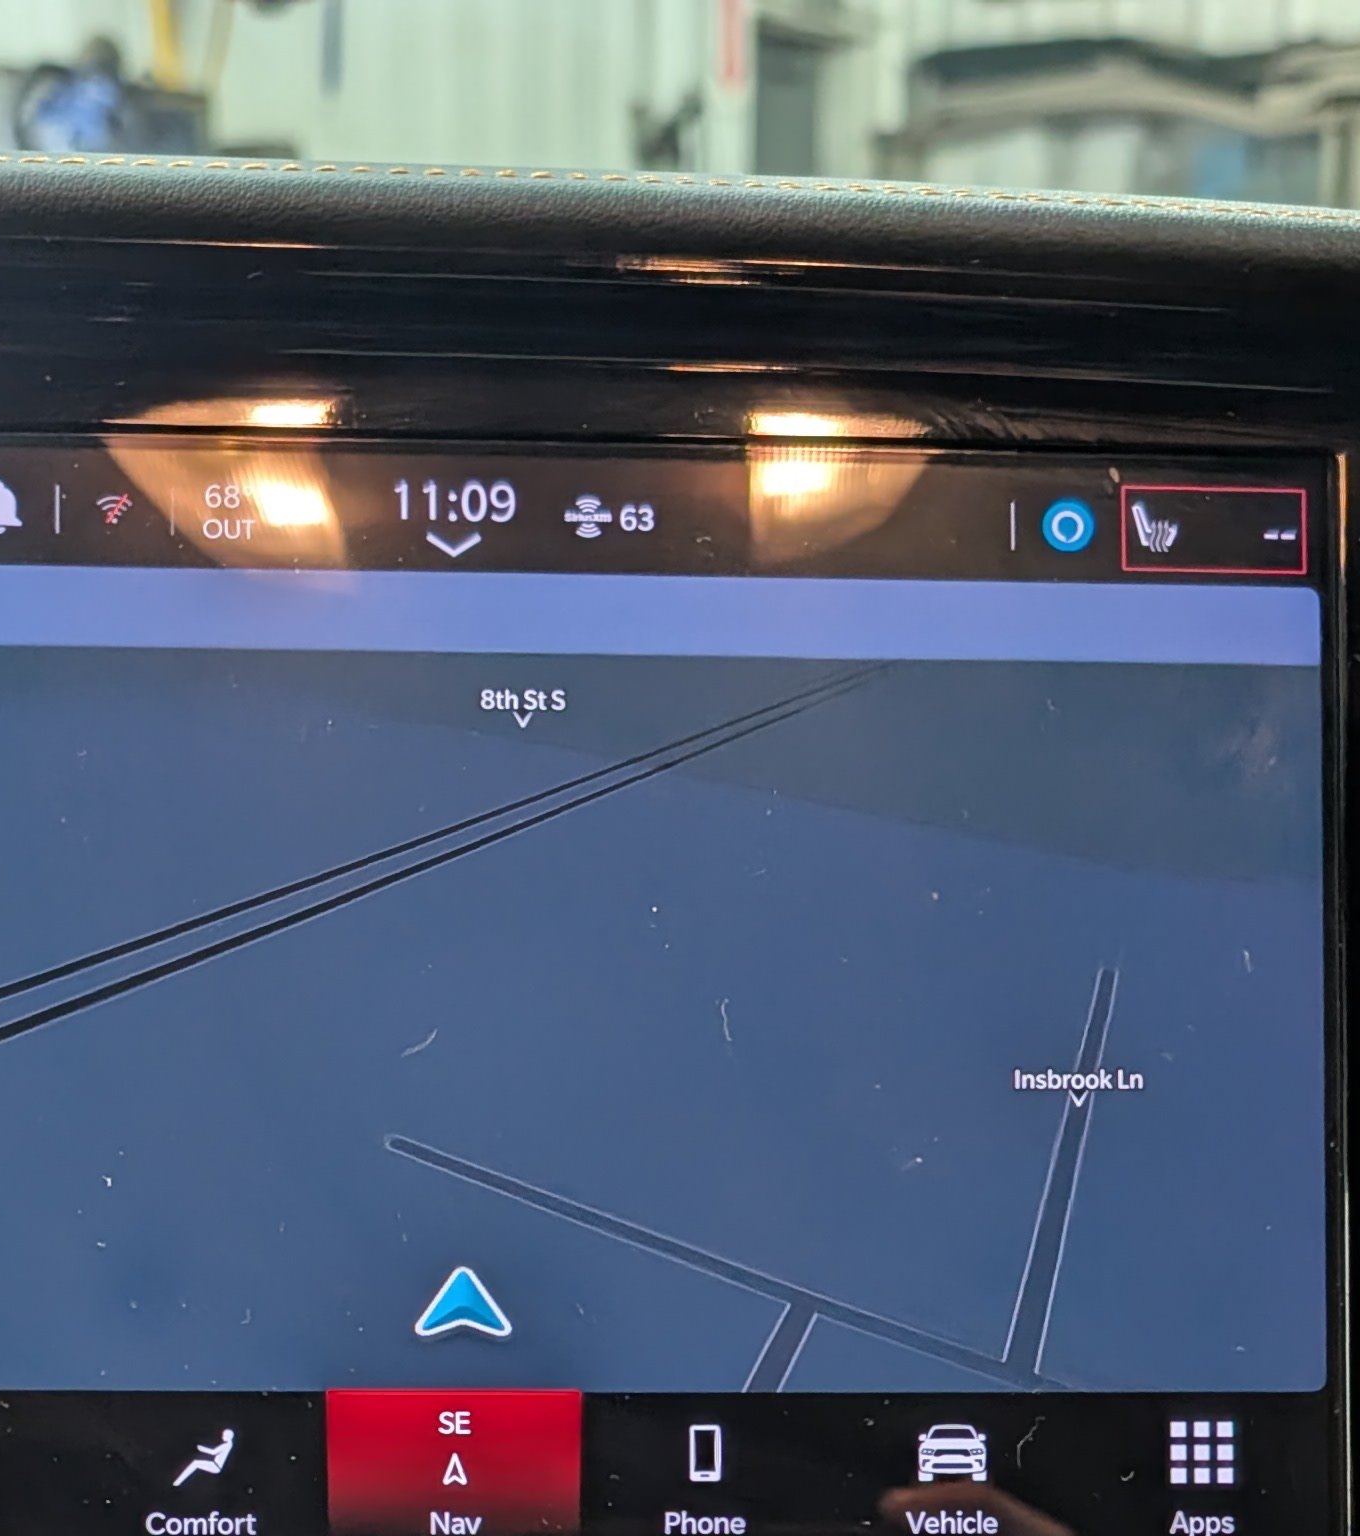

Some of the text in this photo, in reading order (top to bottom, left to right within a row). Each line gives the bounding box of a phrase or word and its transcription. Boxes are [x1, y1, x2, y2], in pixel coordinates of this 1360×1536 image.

[392, 479, 517, 524] 11:09
[201, 518, 255, 542] OUT
[619, 503, 655, 532] 63
[479, 688, 567, 713] 8th St S
[1013, 1068, 1145, 1092] Insbrook Ln
[438, 1411, 472, 1435] SE
[144, 1511, 258, 1536] Comfort
[429, 1512, 482, 1536] Nav
[663, 1509, 747, 1536] Phone
[904, 1509, 999, 1536] Vehicle
